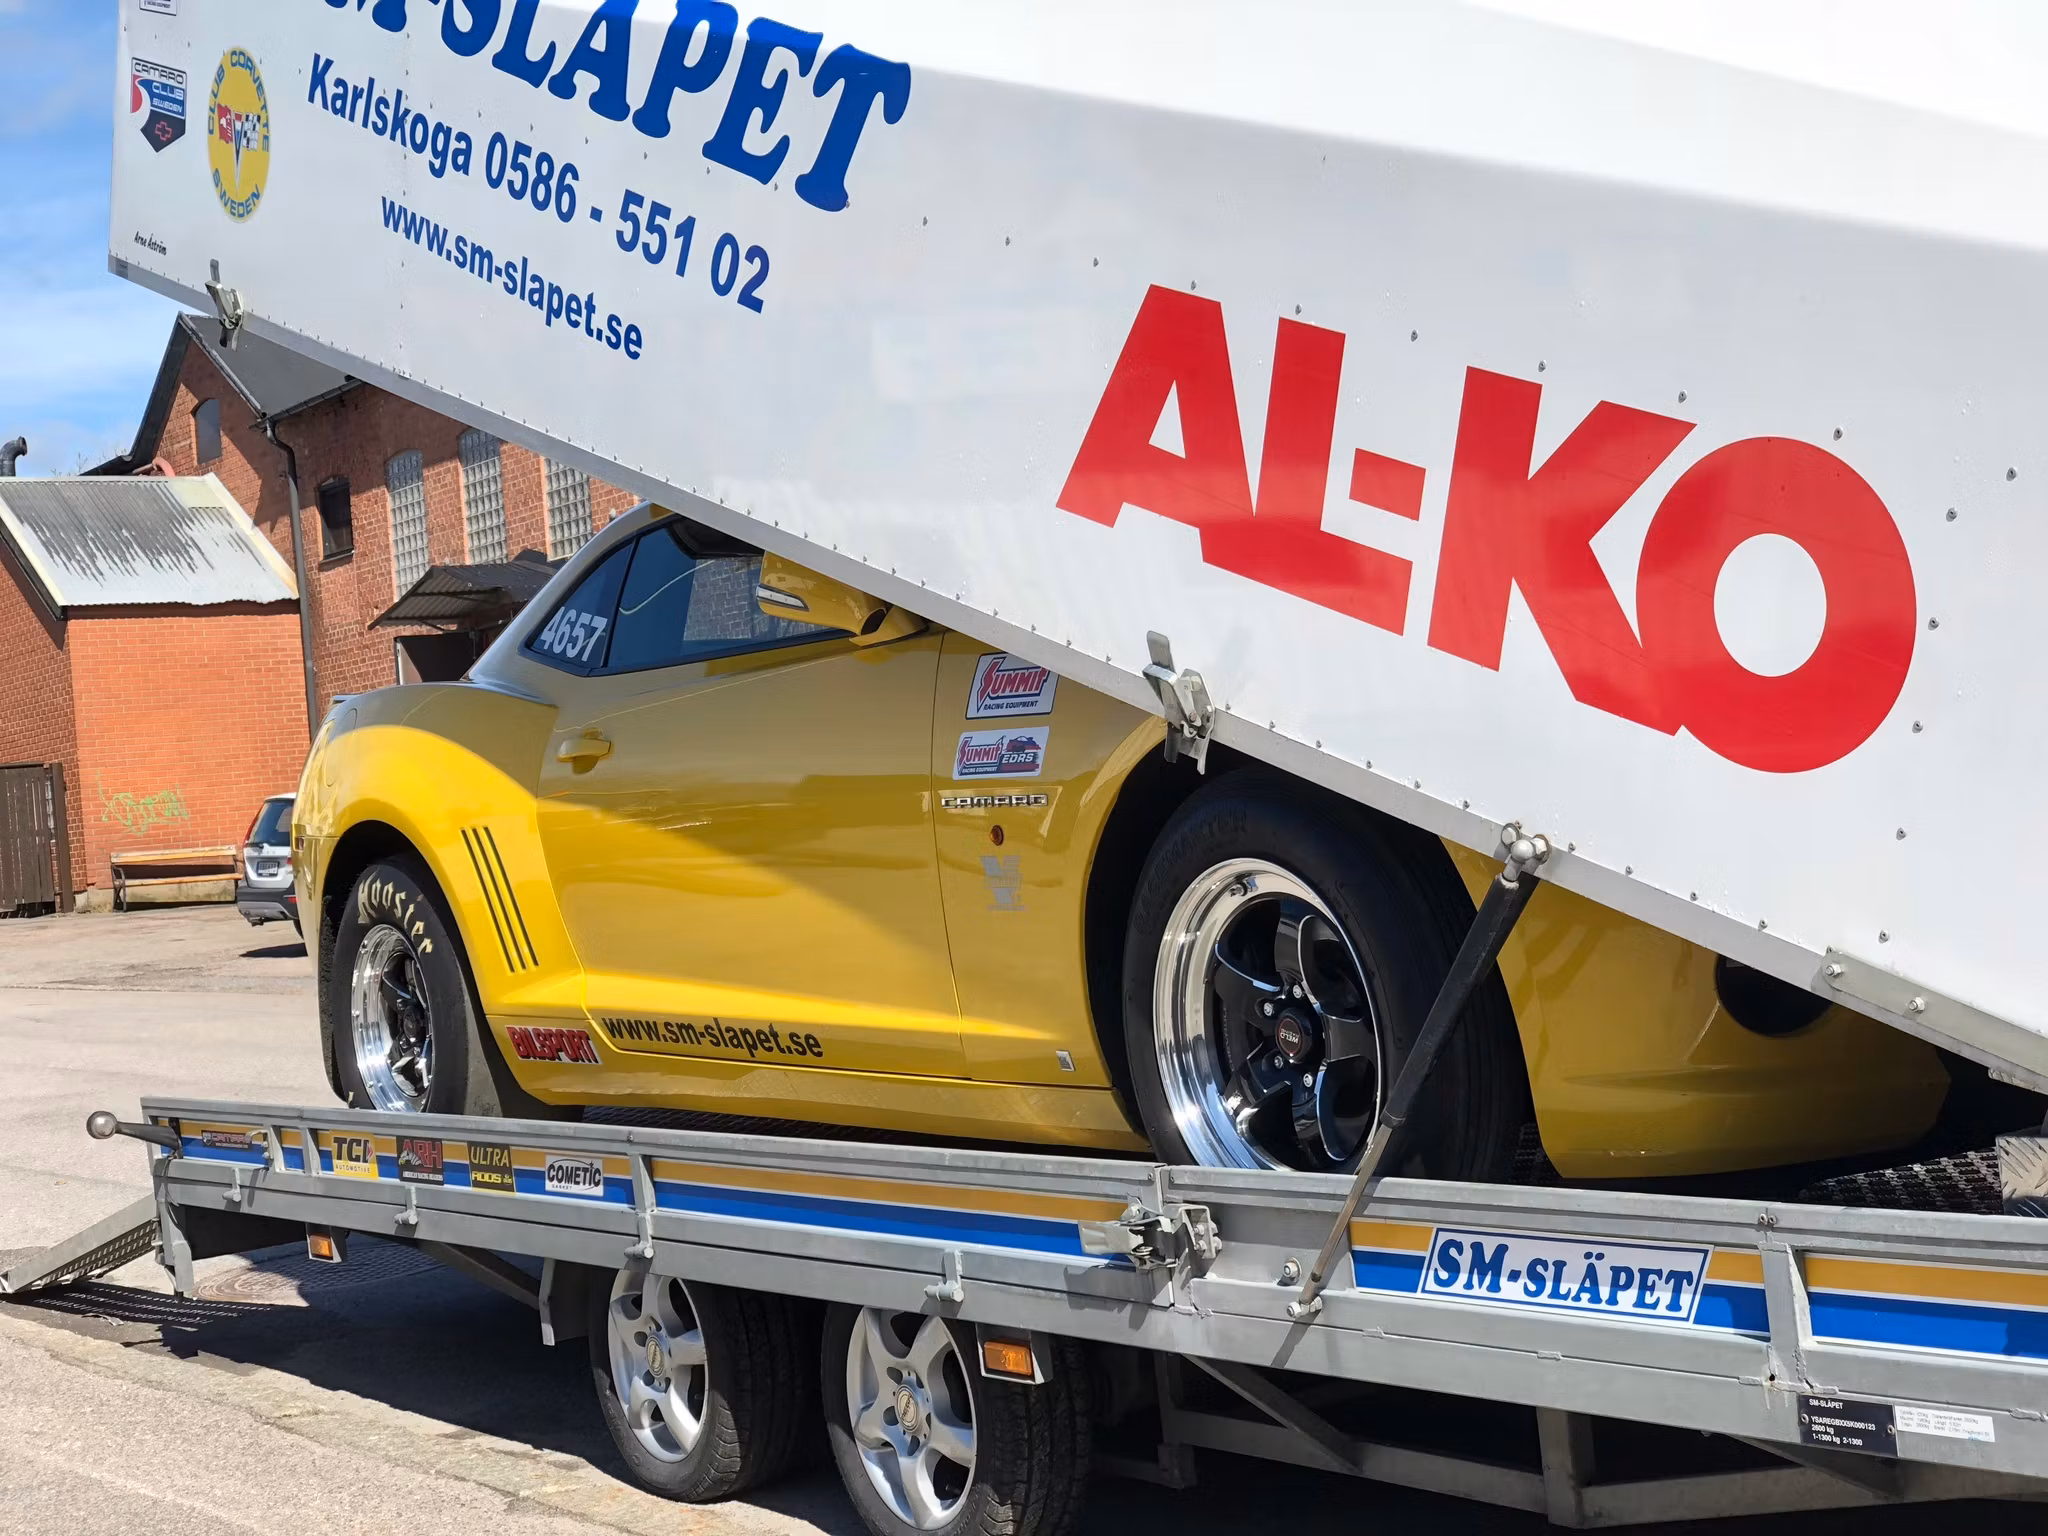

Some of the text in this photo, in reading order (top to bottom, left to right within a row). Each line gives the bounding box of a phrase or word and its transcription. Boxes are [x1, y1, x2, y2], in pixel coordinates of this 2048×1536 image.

[134, 62, 184, 85] CAMARO
[152, 82, 183, 100] CLUB
[207, 50, 270, 152] CLUB CORVETTE
[152, 97, 182, 113] SWEDEN
[213, 167, 261, 218] SWEDEN
[308, 52, 770, 314] Karlskoga 0586 - 551 02
[134, 230, 147, 247] Arne
[382, 195, 643, 360] www.sm-slapet.se
[1056, 284, 1917, 773] AL-KO
[540, 606, 608, 662] 4657
[983, 700, 1039, 711] RACING EQUIPMENT
[1001, 753, 1034, 764] EDRS
[941, 794, 1048, 809] CAMARO
[506, 1027, 599, 1064] BILSPORT
[601, 1016, 824, 1058] www.sm-slapet.se
[1280, 1032, 1299, 1044] WELD
[334, 1136, 369, 1164] TCI
[403, 1138, 443, 1169] ARH
[471, 1146, 510, 1167] ULTRA
[548, 1163, 602, 1188] COMETIC
[1434, 1238, 1693, 1312] SM-SLÄPET
[1811, 1424, 1835, 1435] 2600 kg
[1832, 1435, 1841, 1445] kg
